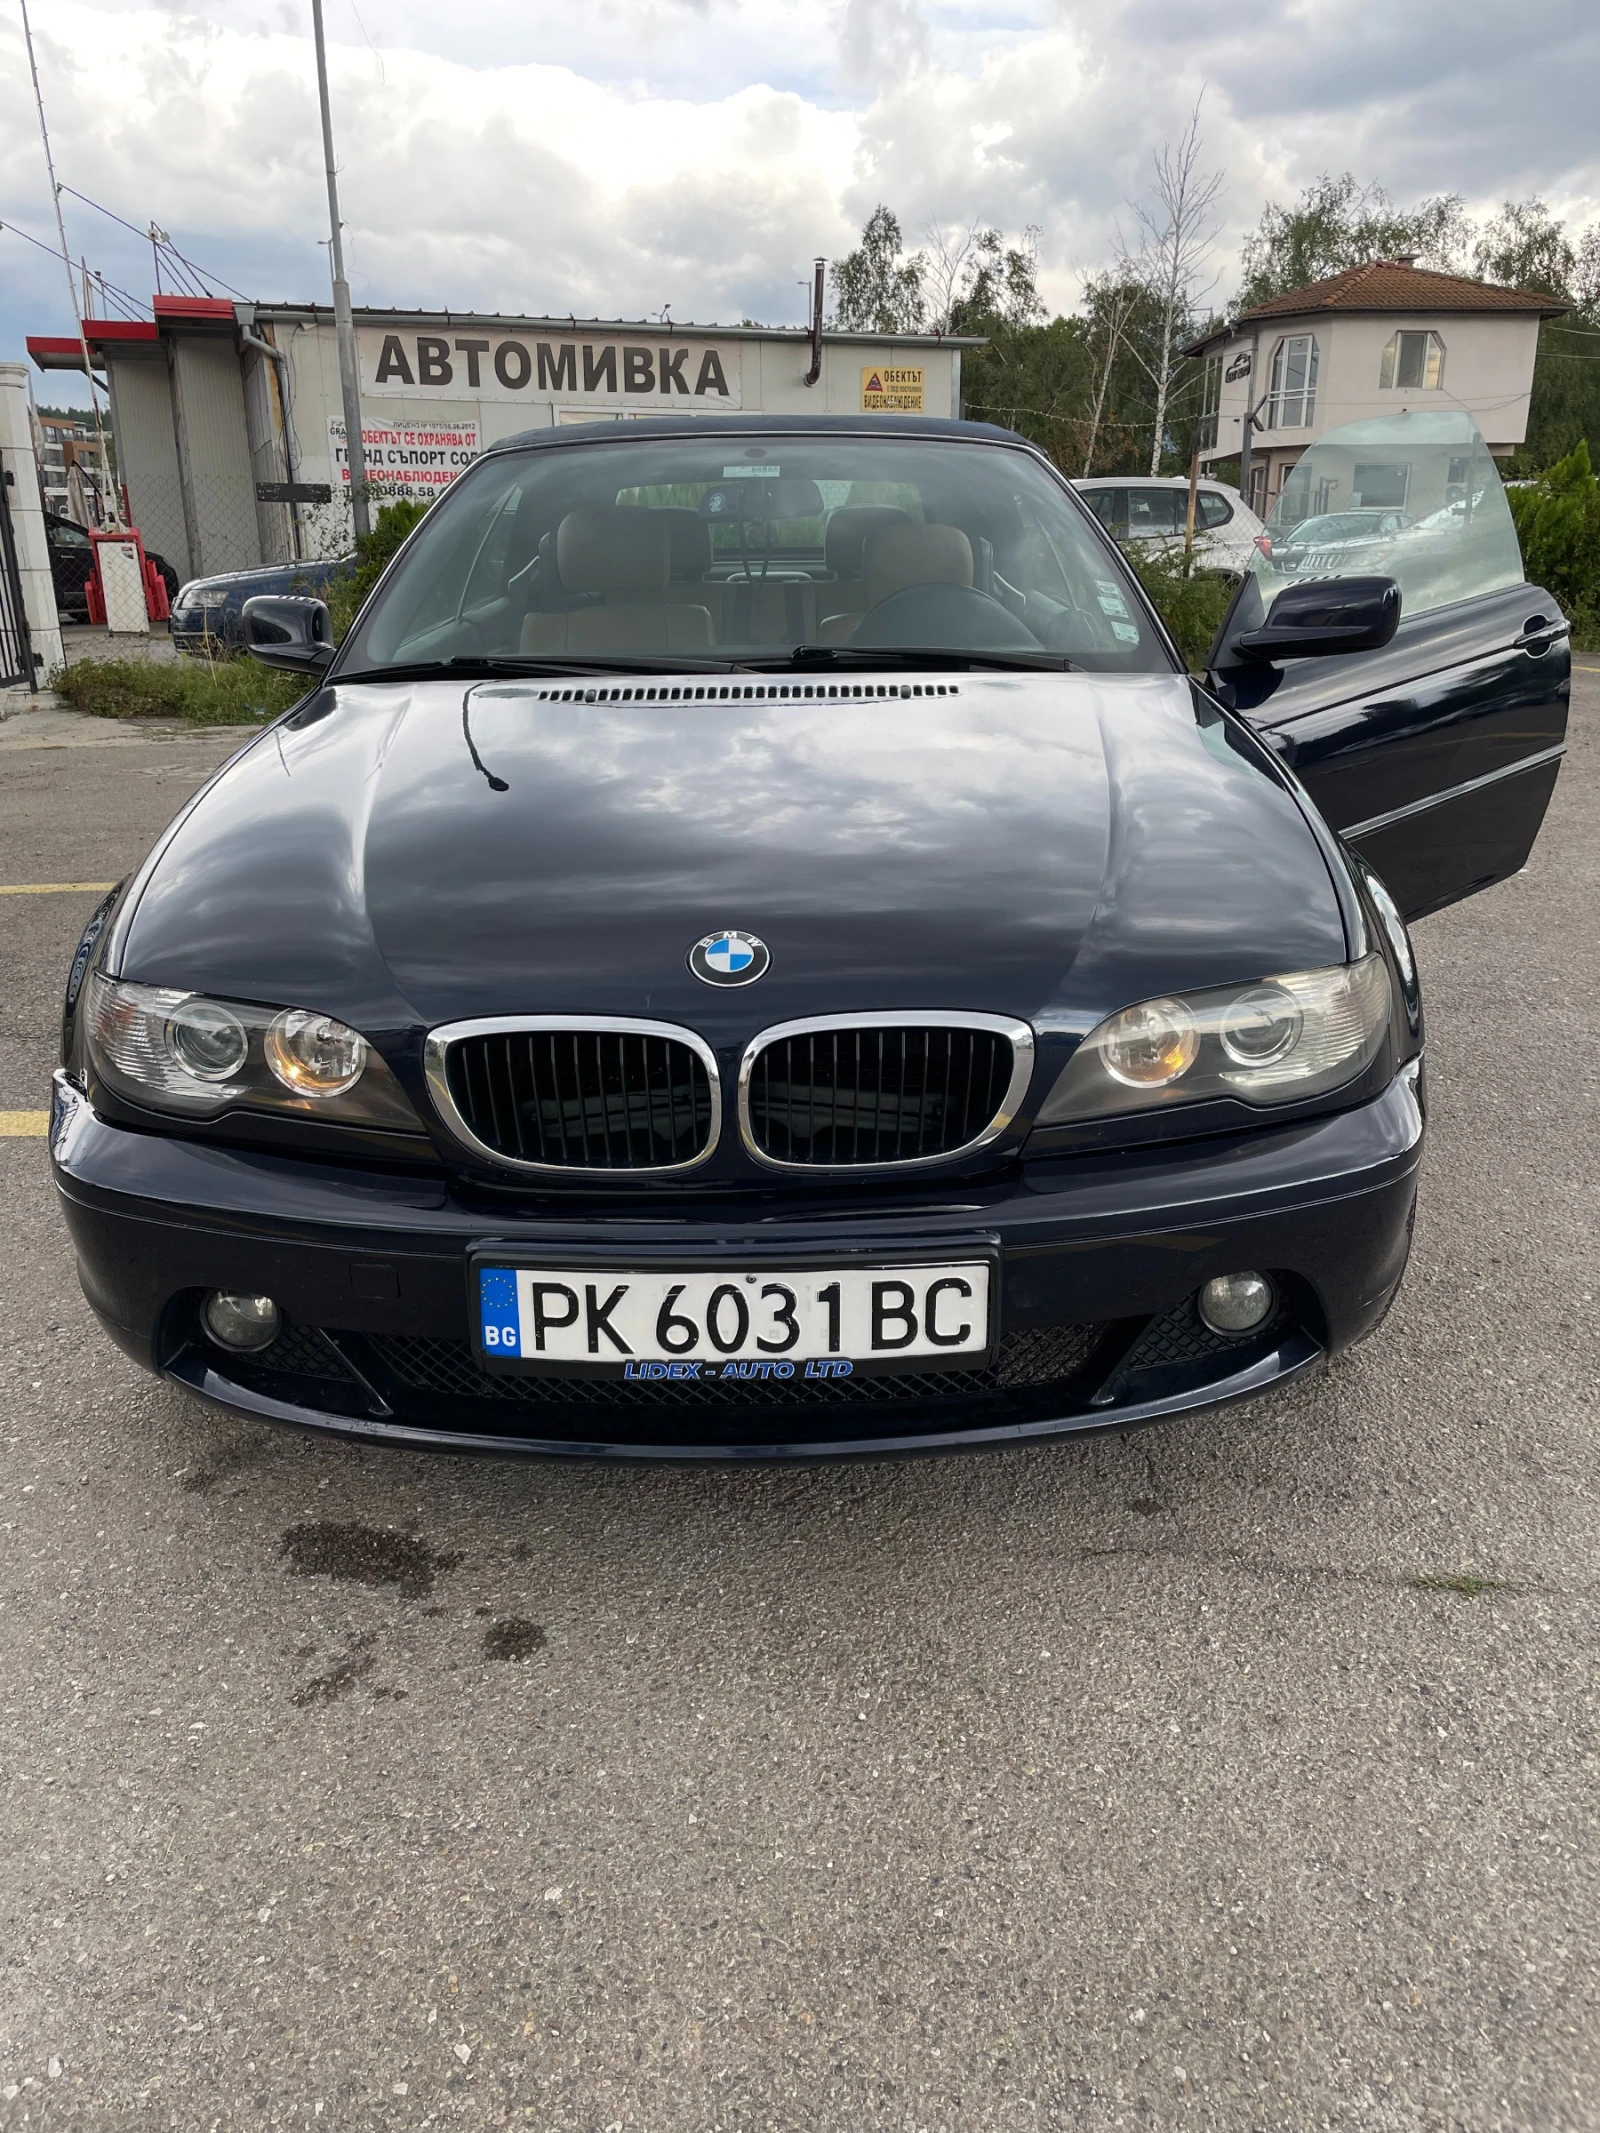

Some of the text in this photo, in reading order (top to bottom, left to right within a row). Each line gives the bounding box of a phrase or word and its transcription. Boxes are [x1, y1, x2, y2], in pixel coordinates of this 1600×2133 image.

[375, 334, 730, 397] АВТОМИВКА
[884, 370, 922, 383] ОБЕКТЪТ
[330, 427, 346, 436] GRA
[393, 421, 420, 430] ЛИЦЕНЗ
[361, 429, 476, 447] ОБЕКТЪТ СЕ ОХРАНЯВА ОТ
[387, 449, 446, 465] СЪПОРТ
[450, 451, 478, 466] СО
[418, 486, 434, 497] 58
[699, 931, 763, 948] BMW
[532, 1277, 972, 1354] PK 6031 BC
[485, 1326, 516, 1347] BG
[624, 1362, 703, 1380] LIDEX
[719, 1361, 795, 1380] AUTO
[804, 1360, 853, 1379] LTD
